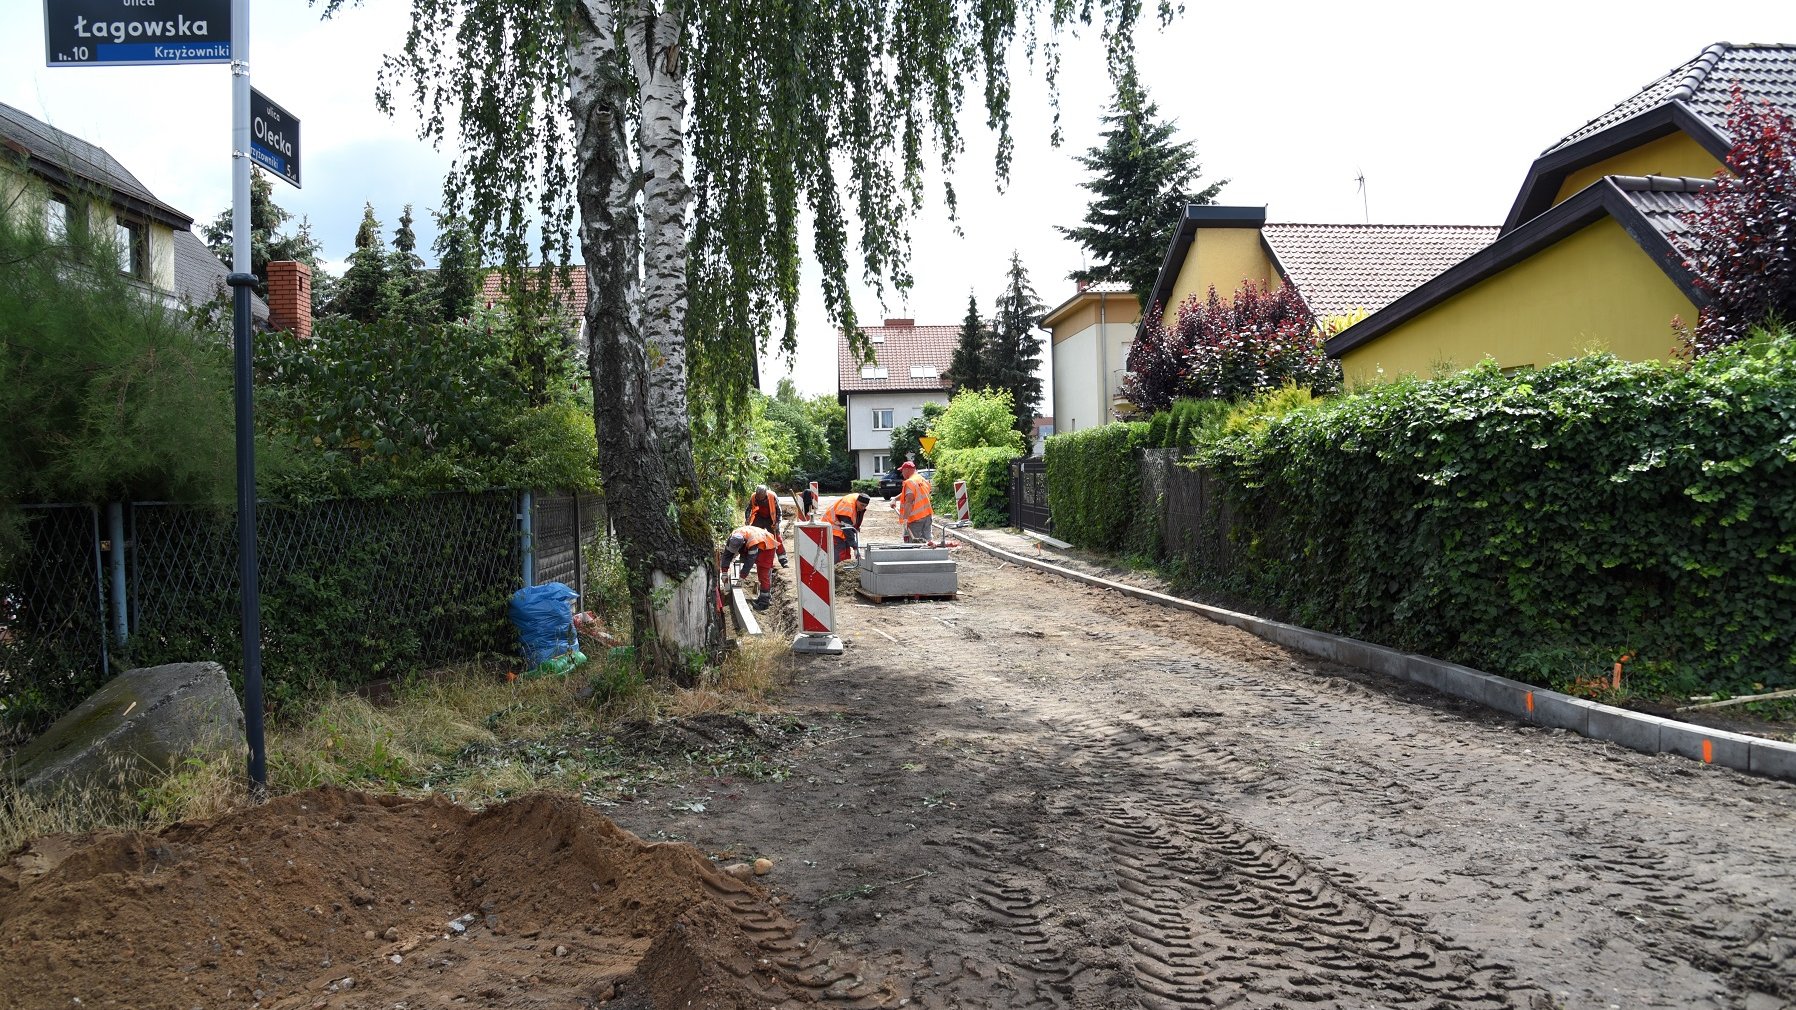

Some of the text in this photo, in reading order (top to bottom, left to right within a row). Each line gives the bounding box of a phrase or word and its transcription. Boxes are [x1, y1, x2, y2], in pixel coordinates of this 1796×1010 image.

[74, 14, 208, 43] Łagowska
[73, 46, 88, 60] 10
[155, 45, 229, 60] Krzyżowniki
[267, 107, 280, 122] ulica
[255, 117, 291, 156] Olecka
